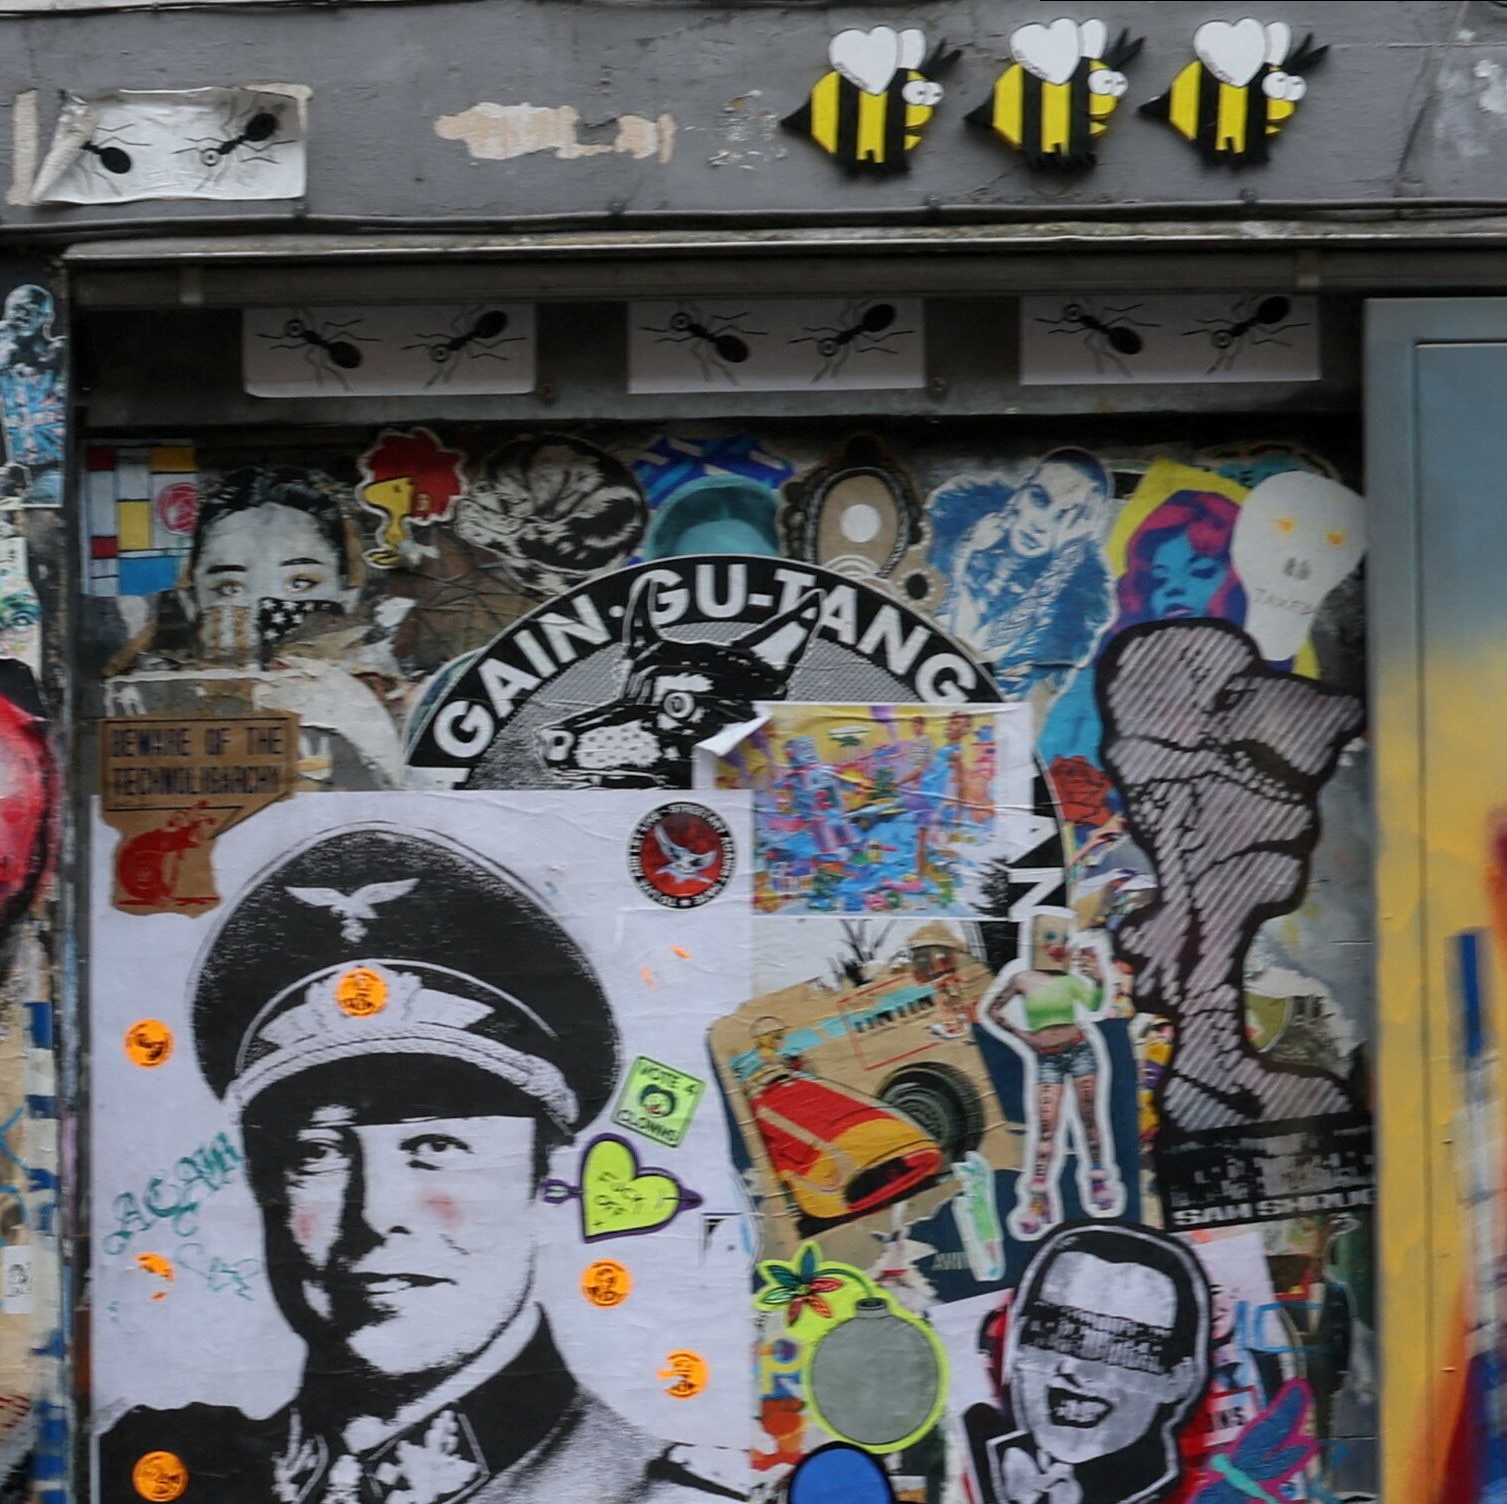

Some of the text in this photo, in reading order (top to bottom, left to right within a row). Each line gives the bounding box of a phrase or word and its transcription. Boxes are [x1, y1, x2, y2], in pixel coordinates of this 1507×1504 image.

[112, 725, 283, 757] BEWARE OF THE
[1172, 1202, 1254, 1227] SAM
